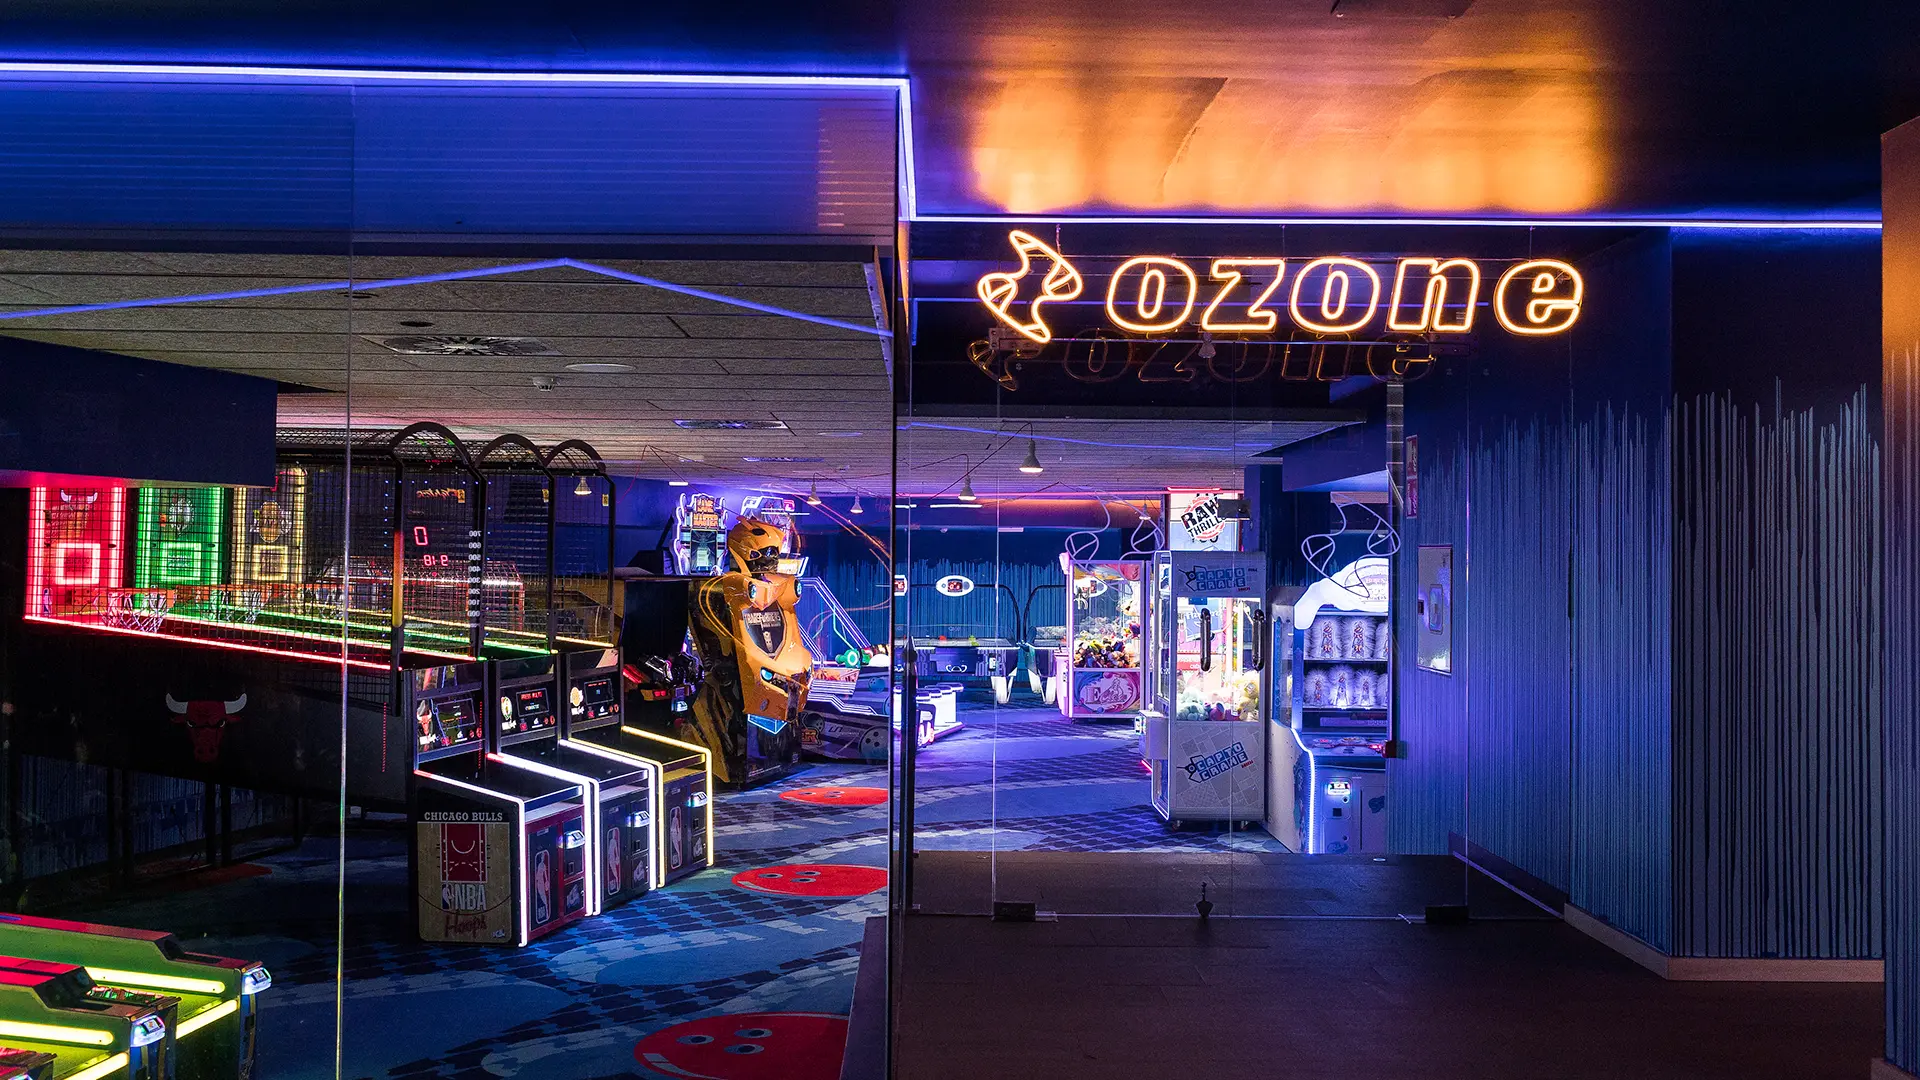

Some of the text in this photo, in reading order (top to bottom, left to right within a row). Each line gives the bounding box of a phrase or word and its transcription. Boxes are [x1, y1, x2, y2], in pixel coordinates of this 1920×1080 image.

[1105, 256, 1585, 334] ozone
[1188, 515, 1227, 537] THRILL
[1196, 569, 1244, 580] CAPTO
[1196, 743, 1243, 771] CAPTO
[1201, 751, 1248, 781] CRANE
[424, 811, 503, 821] CHICAGO BULLS
[455, 883, 487, 911] NBA
